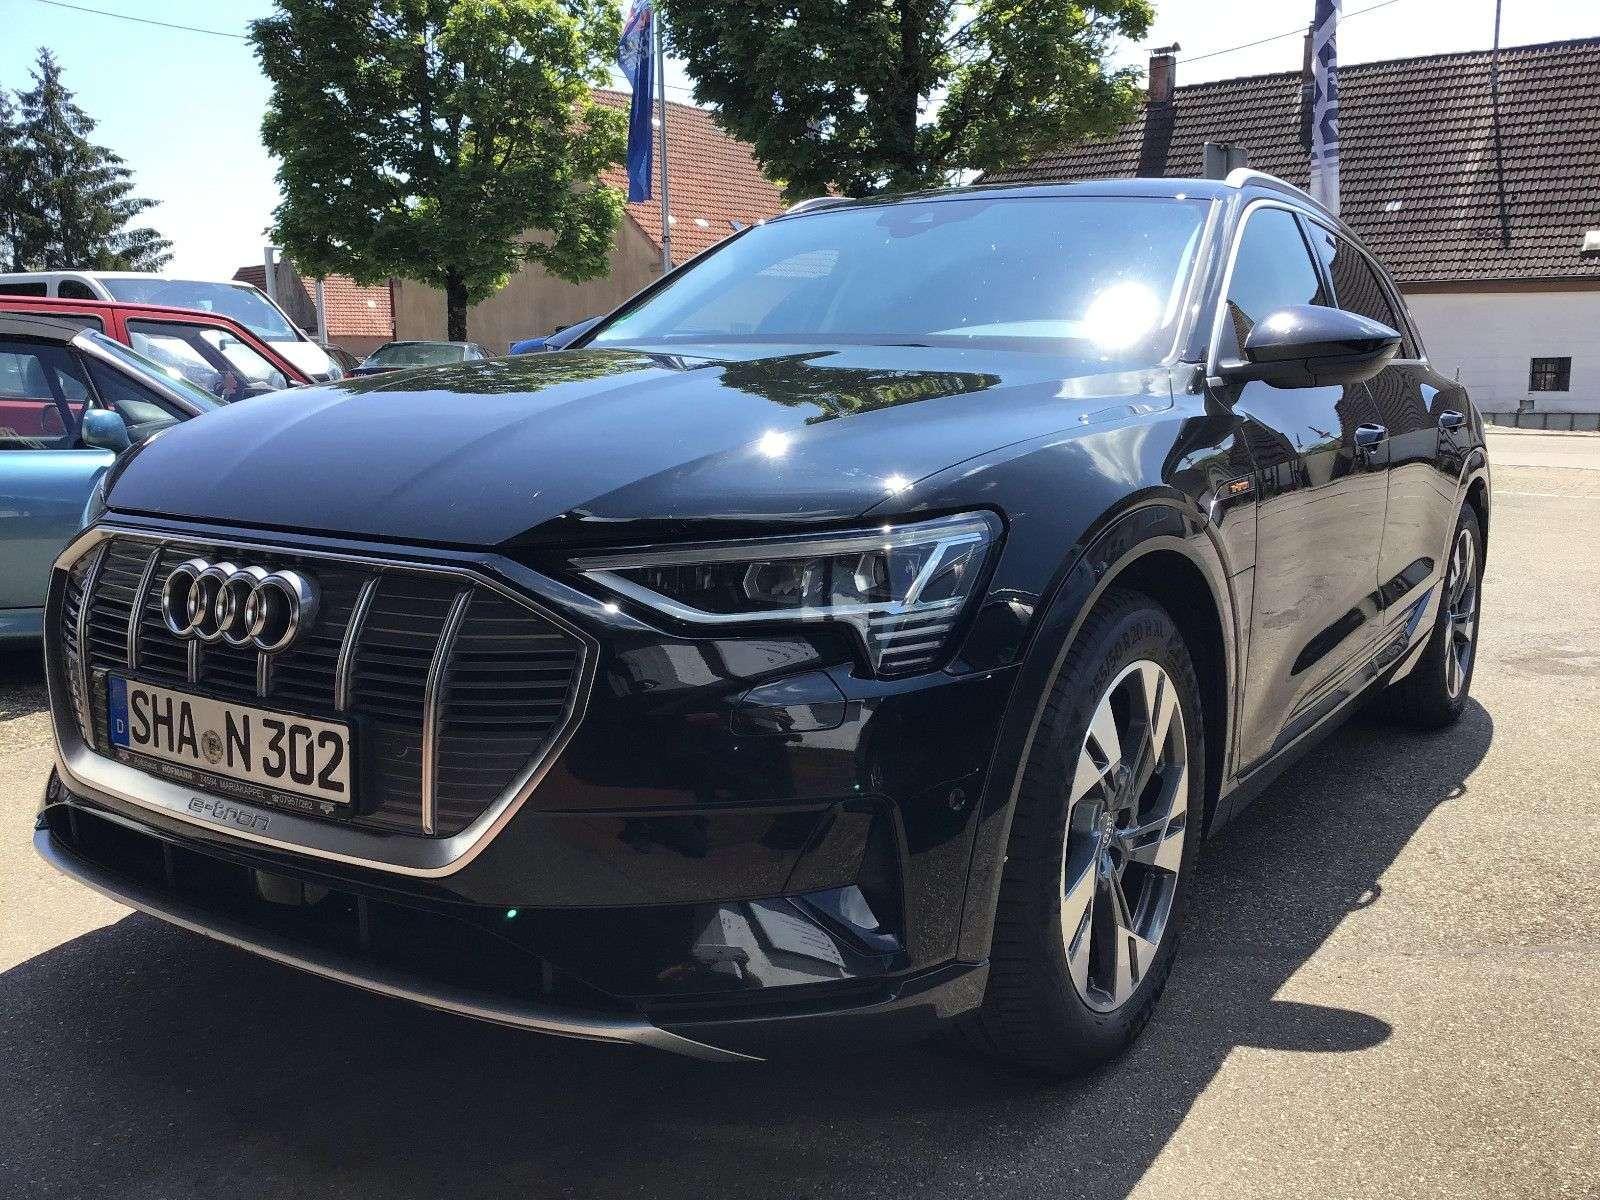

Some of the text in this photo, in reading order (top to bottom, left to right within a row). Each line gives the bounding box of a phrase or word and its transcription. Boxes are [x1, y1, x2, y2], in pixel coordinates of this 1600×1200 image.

[116, 718, 125, 734] D
[131, 689, 345, 793] SHA N 302
[187, 796, 272, 831] e-tron
